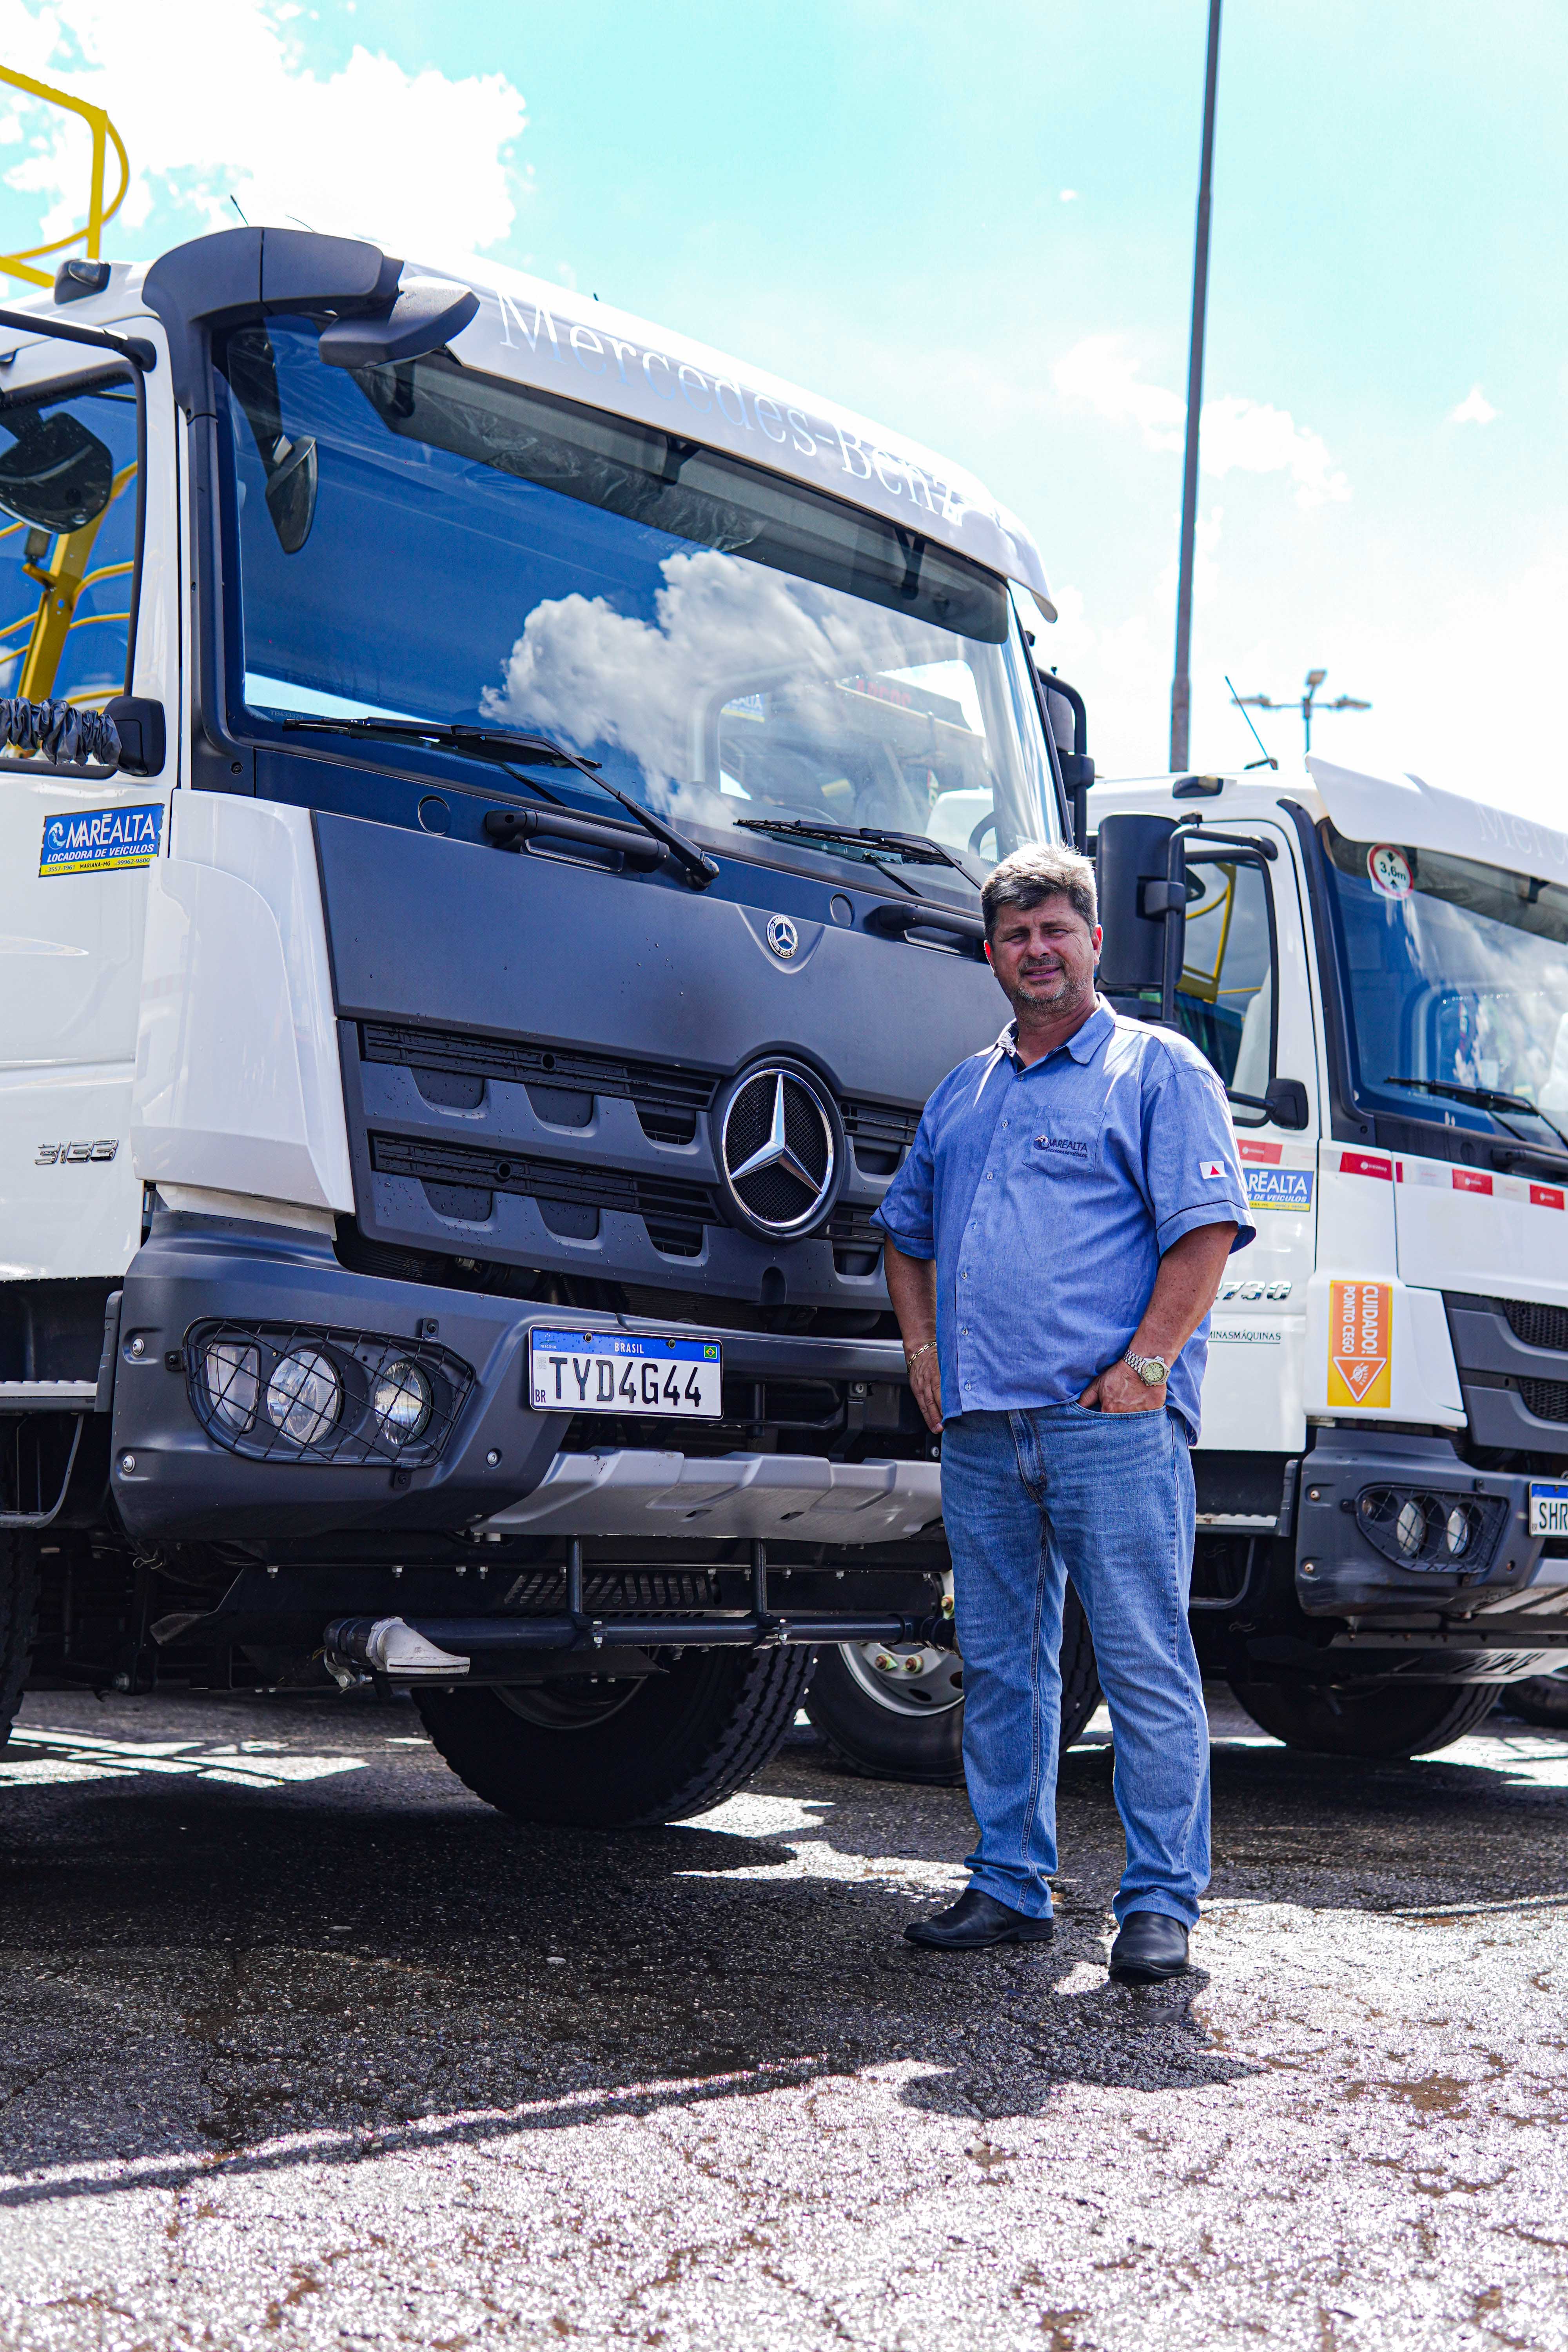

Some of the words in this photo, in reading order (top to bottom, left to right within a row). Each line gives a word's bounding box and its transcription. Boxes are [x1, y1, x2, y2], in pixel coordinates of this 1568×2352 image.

[495, 289, 963, 527] Mercedes-Benz
[1475, 803, 1568, 865] Merc
[47, 850, 92, 863] LOCADORA
[94, 849, 106, 858] DE
[109, 844, 154, 857] VEÍCULOS
[1380, 861, 1406, 881] 3,6m
[34, 1138, 119, 1165] 3133
[1343, 1286, 1356, 1323] PONTO
[1361, 1285, 1379, 1355] CUIDADO!
[614, 1342, 644, 1354] BRASIL
[1342, 1325, 1355, 1354] CEGO
[535, 1389, 546, 1403] BR
[549, 1357, 701, 1407] TYD4G44
